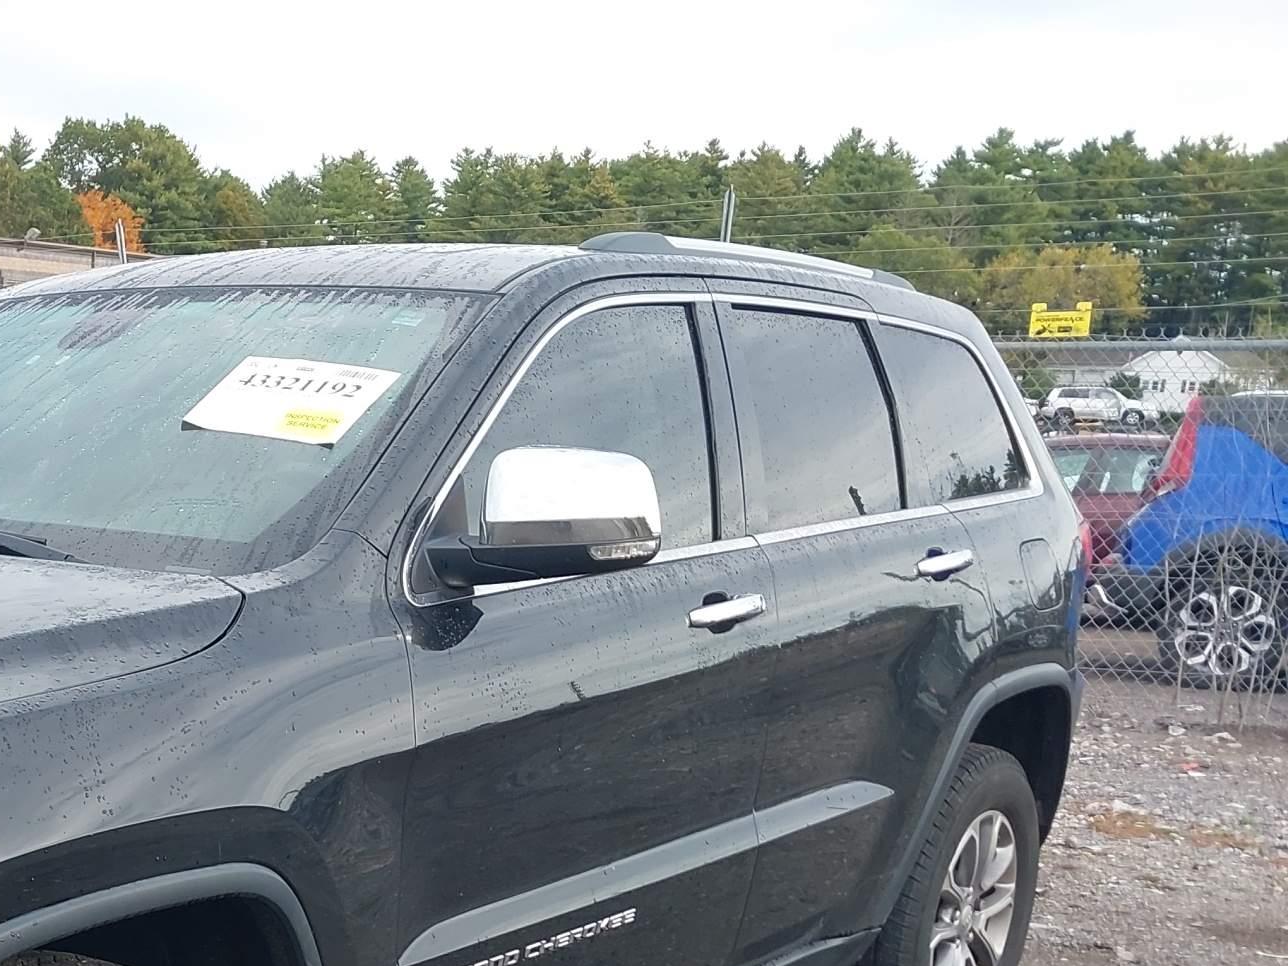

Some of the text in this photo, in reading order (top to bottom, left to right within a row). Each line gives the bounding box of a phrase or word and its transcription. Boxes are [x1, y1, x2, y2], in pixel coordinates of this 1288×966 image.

[238, 372, 363, 398] 43321192
[285, 412, 341, 425] INSPECTION
[285, 419, 329, 431] SERVICE
[524, 908, 637, 958] CHEROKEE
